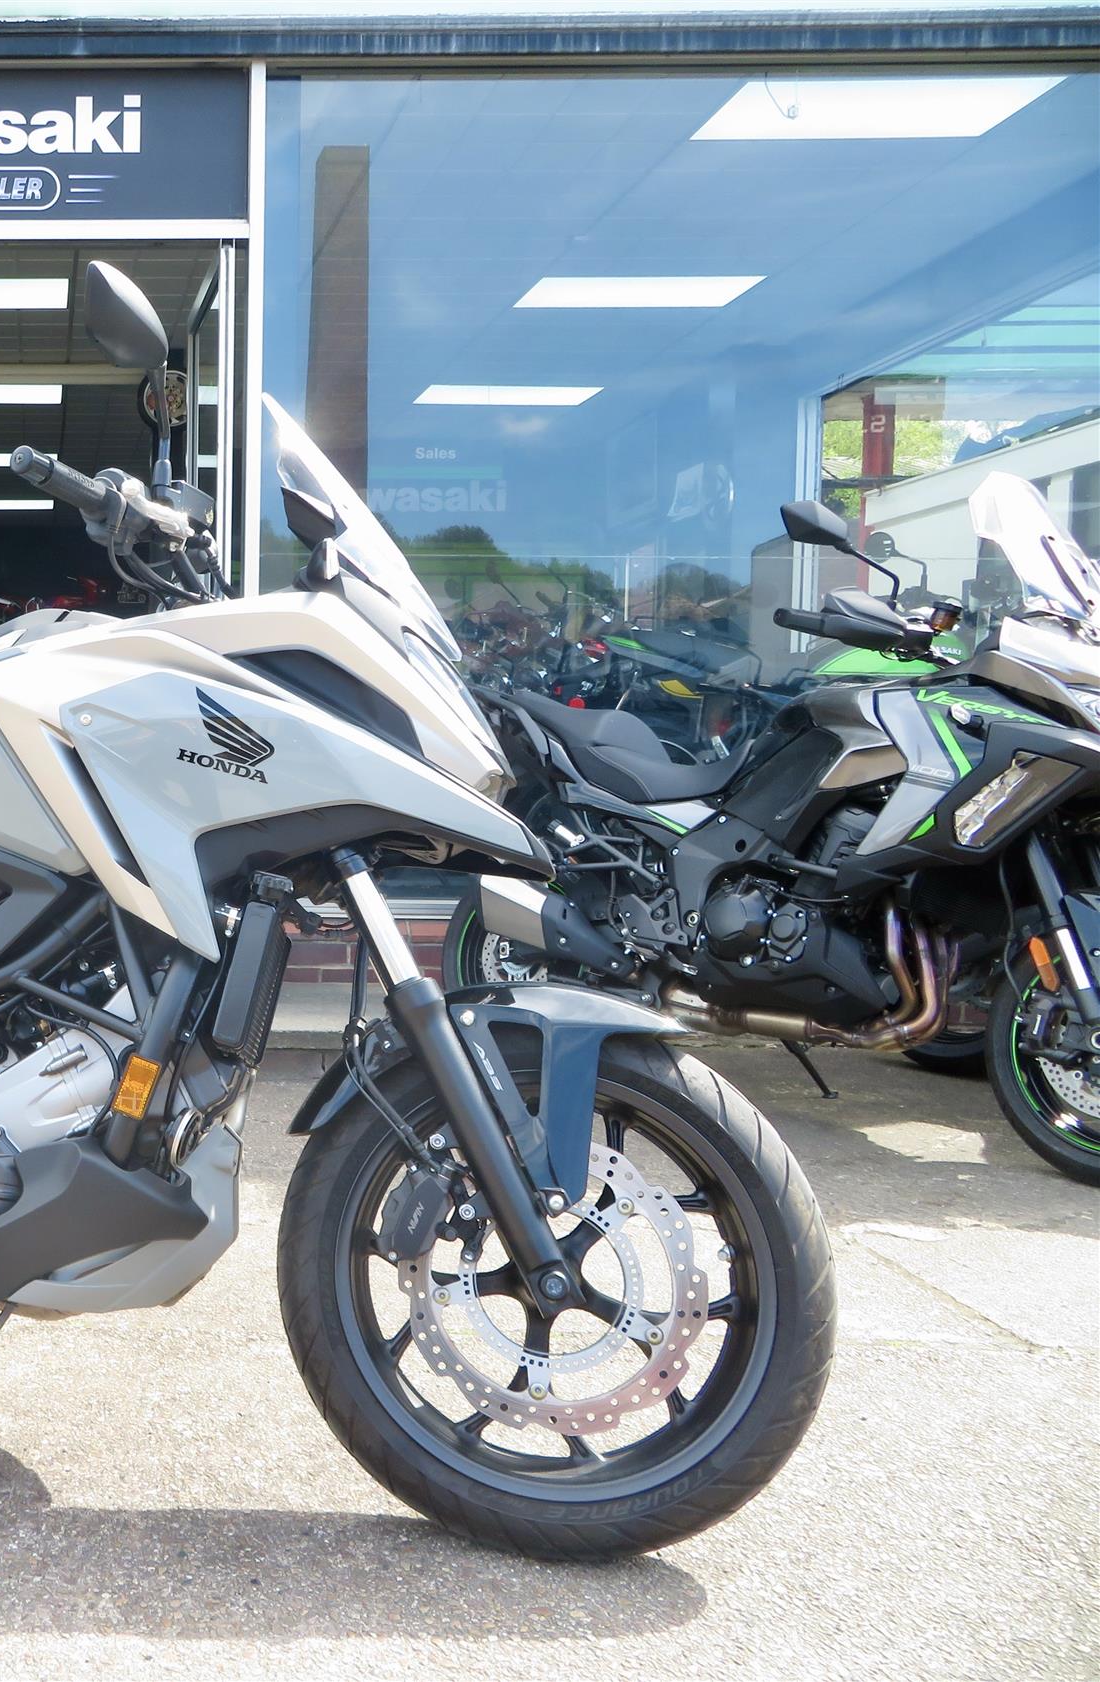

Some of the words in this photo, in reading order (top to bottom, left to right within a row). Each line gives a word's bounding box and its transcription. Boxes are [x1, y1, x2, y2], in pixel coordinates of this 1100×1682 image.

[415, 447, 457, 460] Sales
[364, 480, 507, 512] wasaki
[176, 747, 269, 784] HONDA
[472, 1040, 505, 1091] ABS
[542, 1468, 709, 1521] TOURANCE
